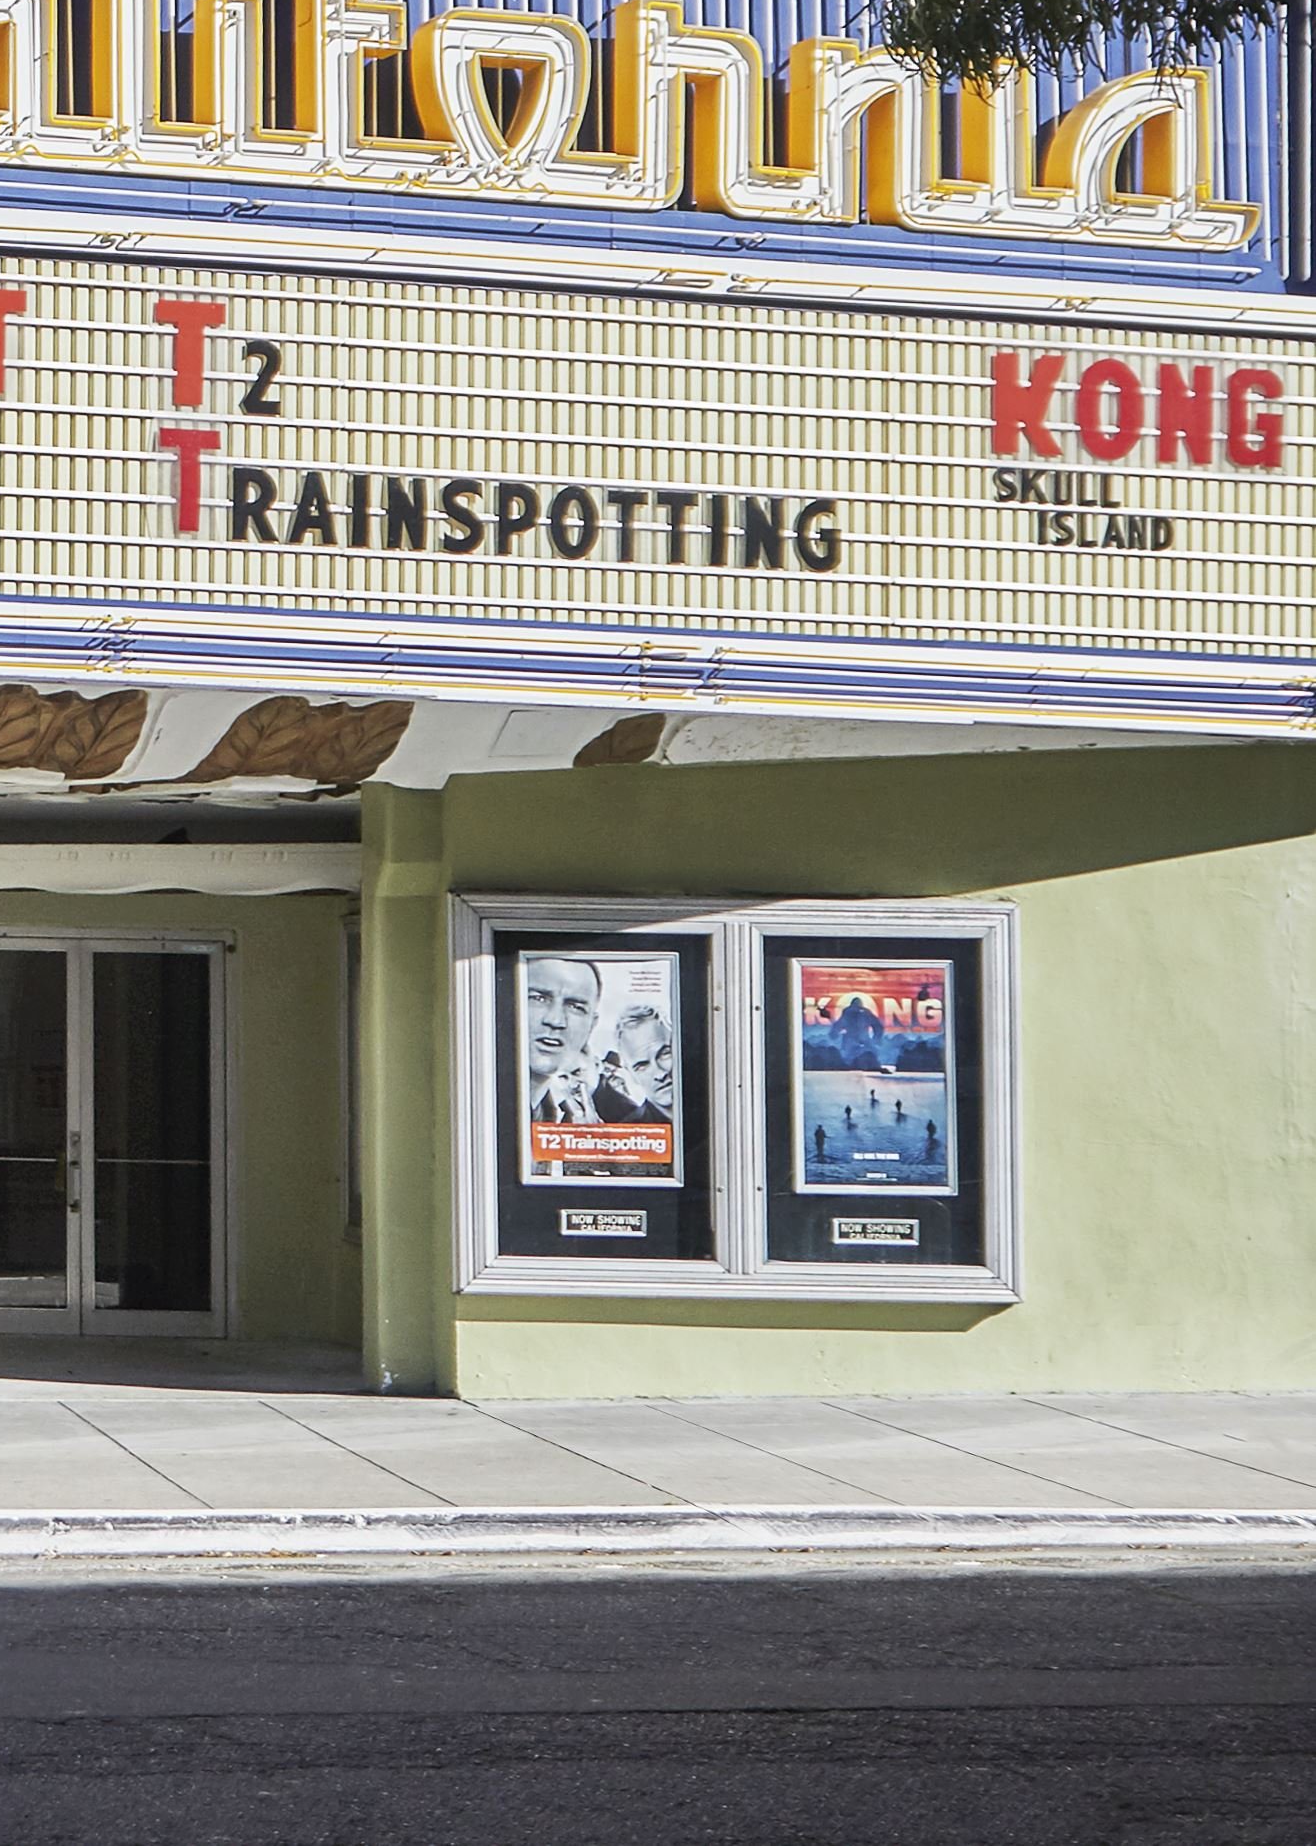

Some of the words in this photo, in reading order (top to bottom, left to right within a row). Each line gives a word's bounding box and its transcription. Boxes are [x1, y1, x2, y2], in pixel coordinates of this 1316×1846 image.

[153, 299, 227, 406] T
[239, 340, 282, 416] 2
[991, 350, 1284, 468] KONG
[159, 428, 843, 572] TRAINSPOTTING
[993, 467, 1121, 508] SKULL
[1038, 512, 1175, 555] ISLAND
[538, 1134, 561, 1149] T2
[561, 1134, 666, 1153] Trainspotting
[571, 1215, 594, 1224] NOW
[841, 1223, 863, 1232] NOW
[866, 1223, 911, 1234] SHOWING
